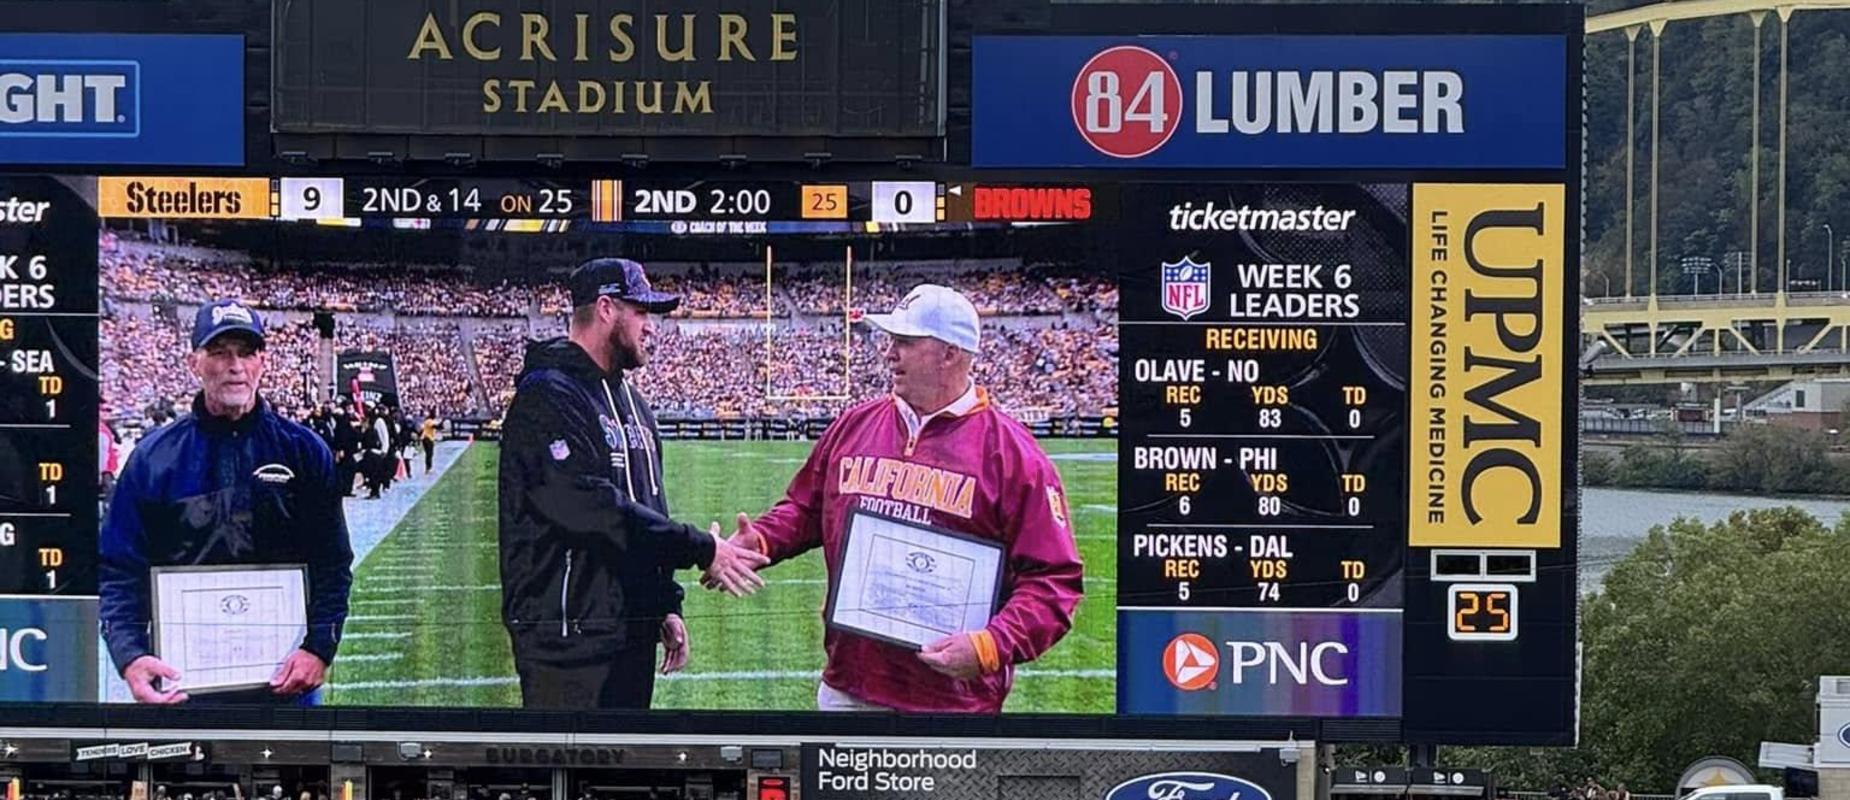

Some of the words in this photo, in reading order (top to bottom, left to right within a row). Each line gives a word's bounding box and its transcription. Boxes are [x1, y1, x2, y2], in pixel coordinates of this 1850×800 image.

[407, 12, 798, 62] ACRISURE
[483, 78, 714, 114] STADIUM
[1086, 70, 1168, 133] 84
[1196, 70, 1464, 134] LUMBER
[127, 181, 241, 213] Steelers
[303, 186, 321, 210] 9
[362, 187, 421, 212] 2ND
[426, 194, 442, 212] &
[449, 187, 481, 212] 14
[501, 195, 531, 212] ON
[539, 189, 572, 213] 25
[635, 189, 697, 213] 2ND
[710, 189, 770, 214] 2:00
[812, 193, 837, 211] 25
[894, 190, 913, 215] 0
[973, 187, 1092, 219] BROWNS
[1169, 202, 1356, 231] ticketmaster
[1430, 211, 1448, 262] LIFE
[29, 255, 47, 280] 6
[1238, 264, 1322, 288] WEEK
[1334, 264, 1351, 289] 6
[0, 283, 55, 308] ERS
[1168, 284, 1204, 308] NFL
[1230, 293, 1360, 318] LEADERS
[1206, 328, 1317, 350] RECEIVING
[1429, 270, 1448, 400] CHANGING
[12, 349, 55, 373] SEA
[1135, 359, 1205, 382] OLAVE
[1228, 360, 1259, 382] NO
[1461, 202, 1545, 525] UPMC
[38, 376, 63, 394] TD
[1166, 386, 1201, 404] REC
[1252, 386, 1288, 405] YDS
[1342, 386, 1366, 405] TD
[46, 399, 56, 418] 1
[1180, 409, 1191, 427] 5
[1259, 409, 1282, 428] 83
[1349, 409, 1361, 428] 0
[1134, 447, 1216, 470] BROWN
[1240, 448, 1277, 470] PHI
[1428, 407, 1446, 524] MEDICINE
[38, 463, 63, 481] TD
[1165, 473, 1200, 491] REC
[1251, 474, 1288, 492] YDS
[1342, 474, 1366, 492] TD
[46, 485, 56, 504] 1
[839, 456, 977, 518] CALIFORNIA
[860, 495, 932, 525] FOOTBALL
[1179, 497, 1190, 515] 6
[1258, 497, 1281, 516] 80
[1348, 497, 1360, 516] 0
[38, 549, 63, 566] TD
[1133, 534, 1228, 558] PICKENS
[1250, 535, 1293, 558] DAL
[46, 570, 56, 589] 1
[1165, 560, 1200, 578] REC
[1251, 560, 1287, 579] YDS
[1341, 561, 1365, 579] TD
[1179, 582, 1190, 601] 5
[1258, 582, 1280, 601] 74
[1348, 583, 1360, 602] 0
[1456, 592, 1509, 633] 25
[1225, 641, 1349, 686] PNC
[121, 744, 146, 755] LOVE
[486, 747, 625, 765] BURGATORY
[818, 748, 977, 772] Neighborhood
[818, 771, 869, 791] Ford
[874, 772, 935, 791] Store
